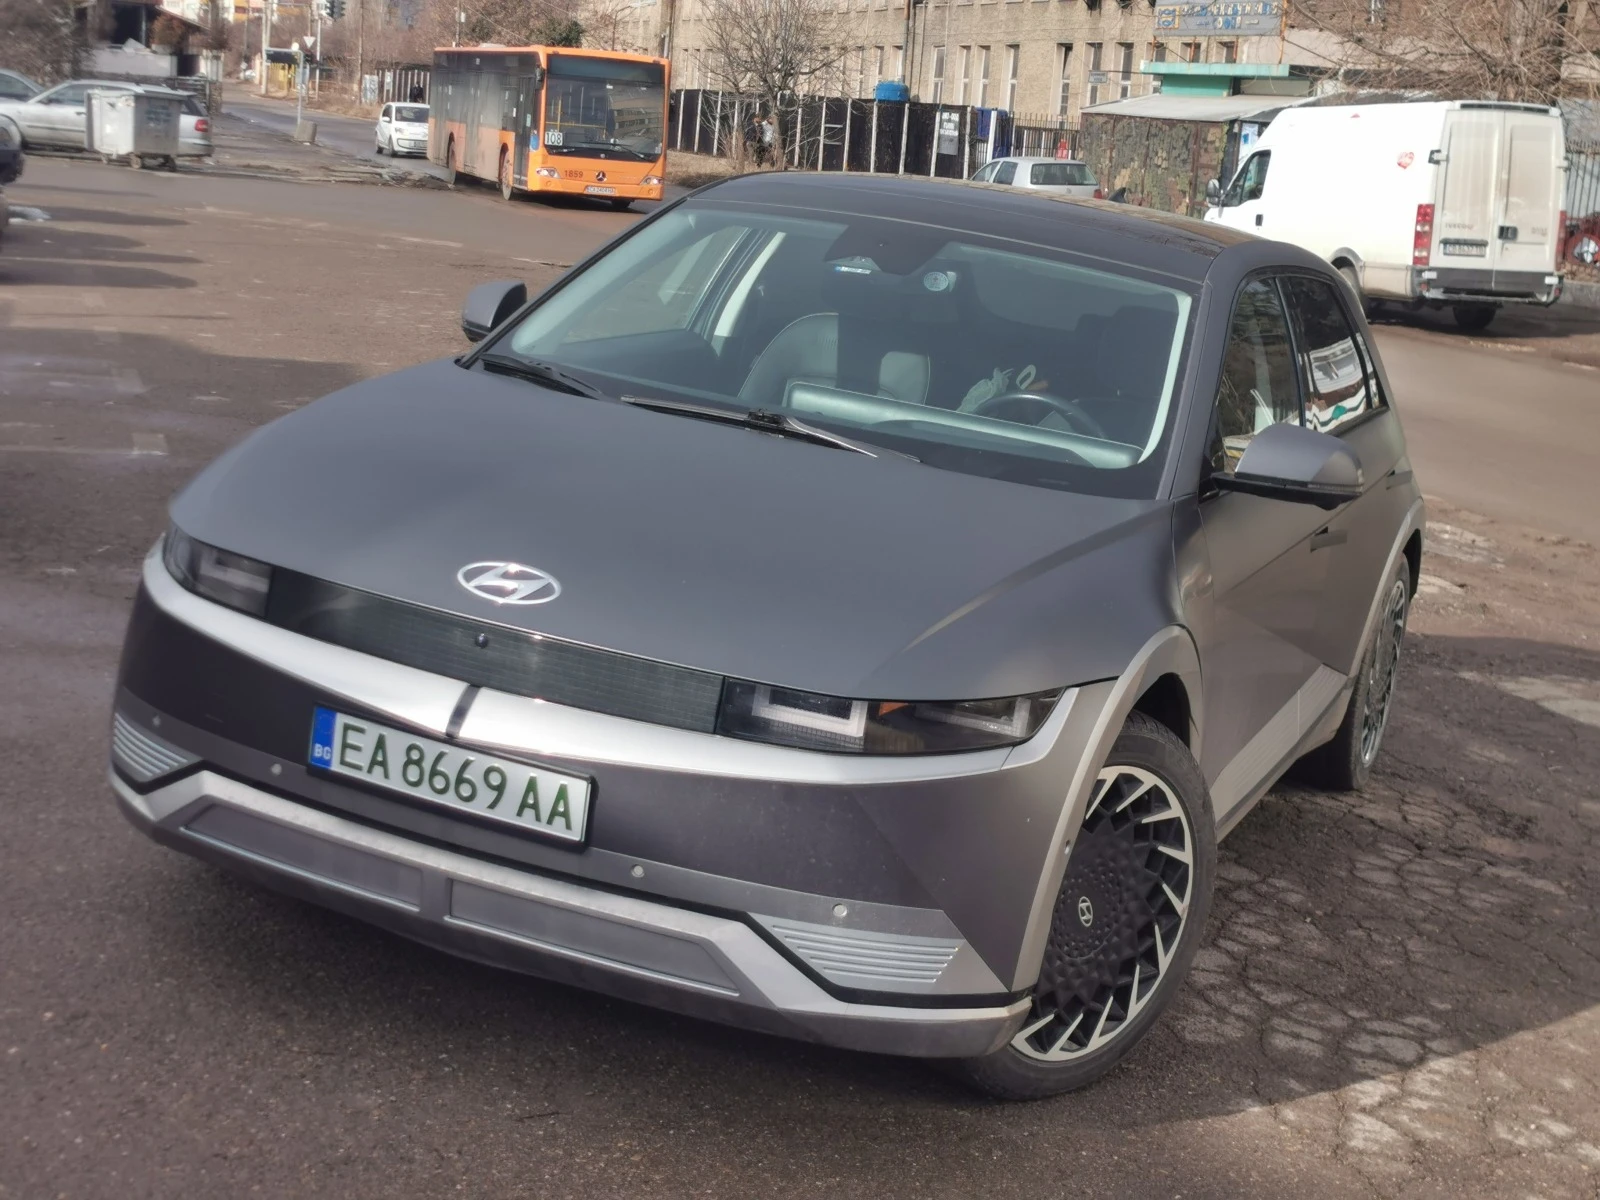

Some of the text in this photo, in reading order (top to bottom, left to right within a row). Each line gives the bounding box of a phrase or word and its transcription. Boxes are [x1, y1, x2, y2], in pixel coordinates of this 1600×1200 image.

[546, 131, 562, 145] 108
[564, 170, 584, 179] 1859
[314, 743, 332, 760] BG
[339, 721, 572, 831] EA 8669 AA
